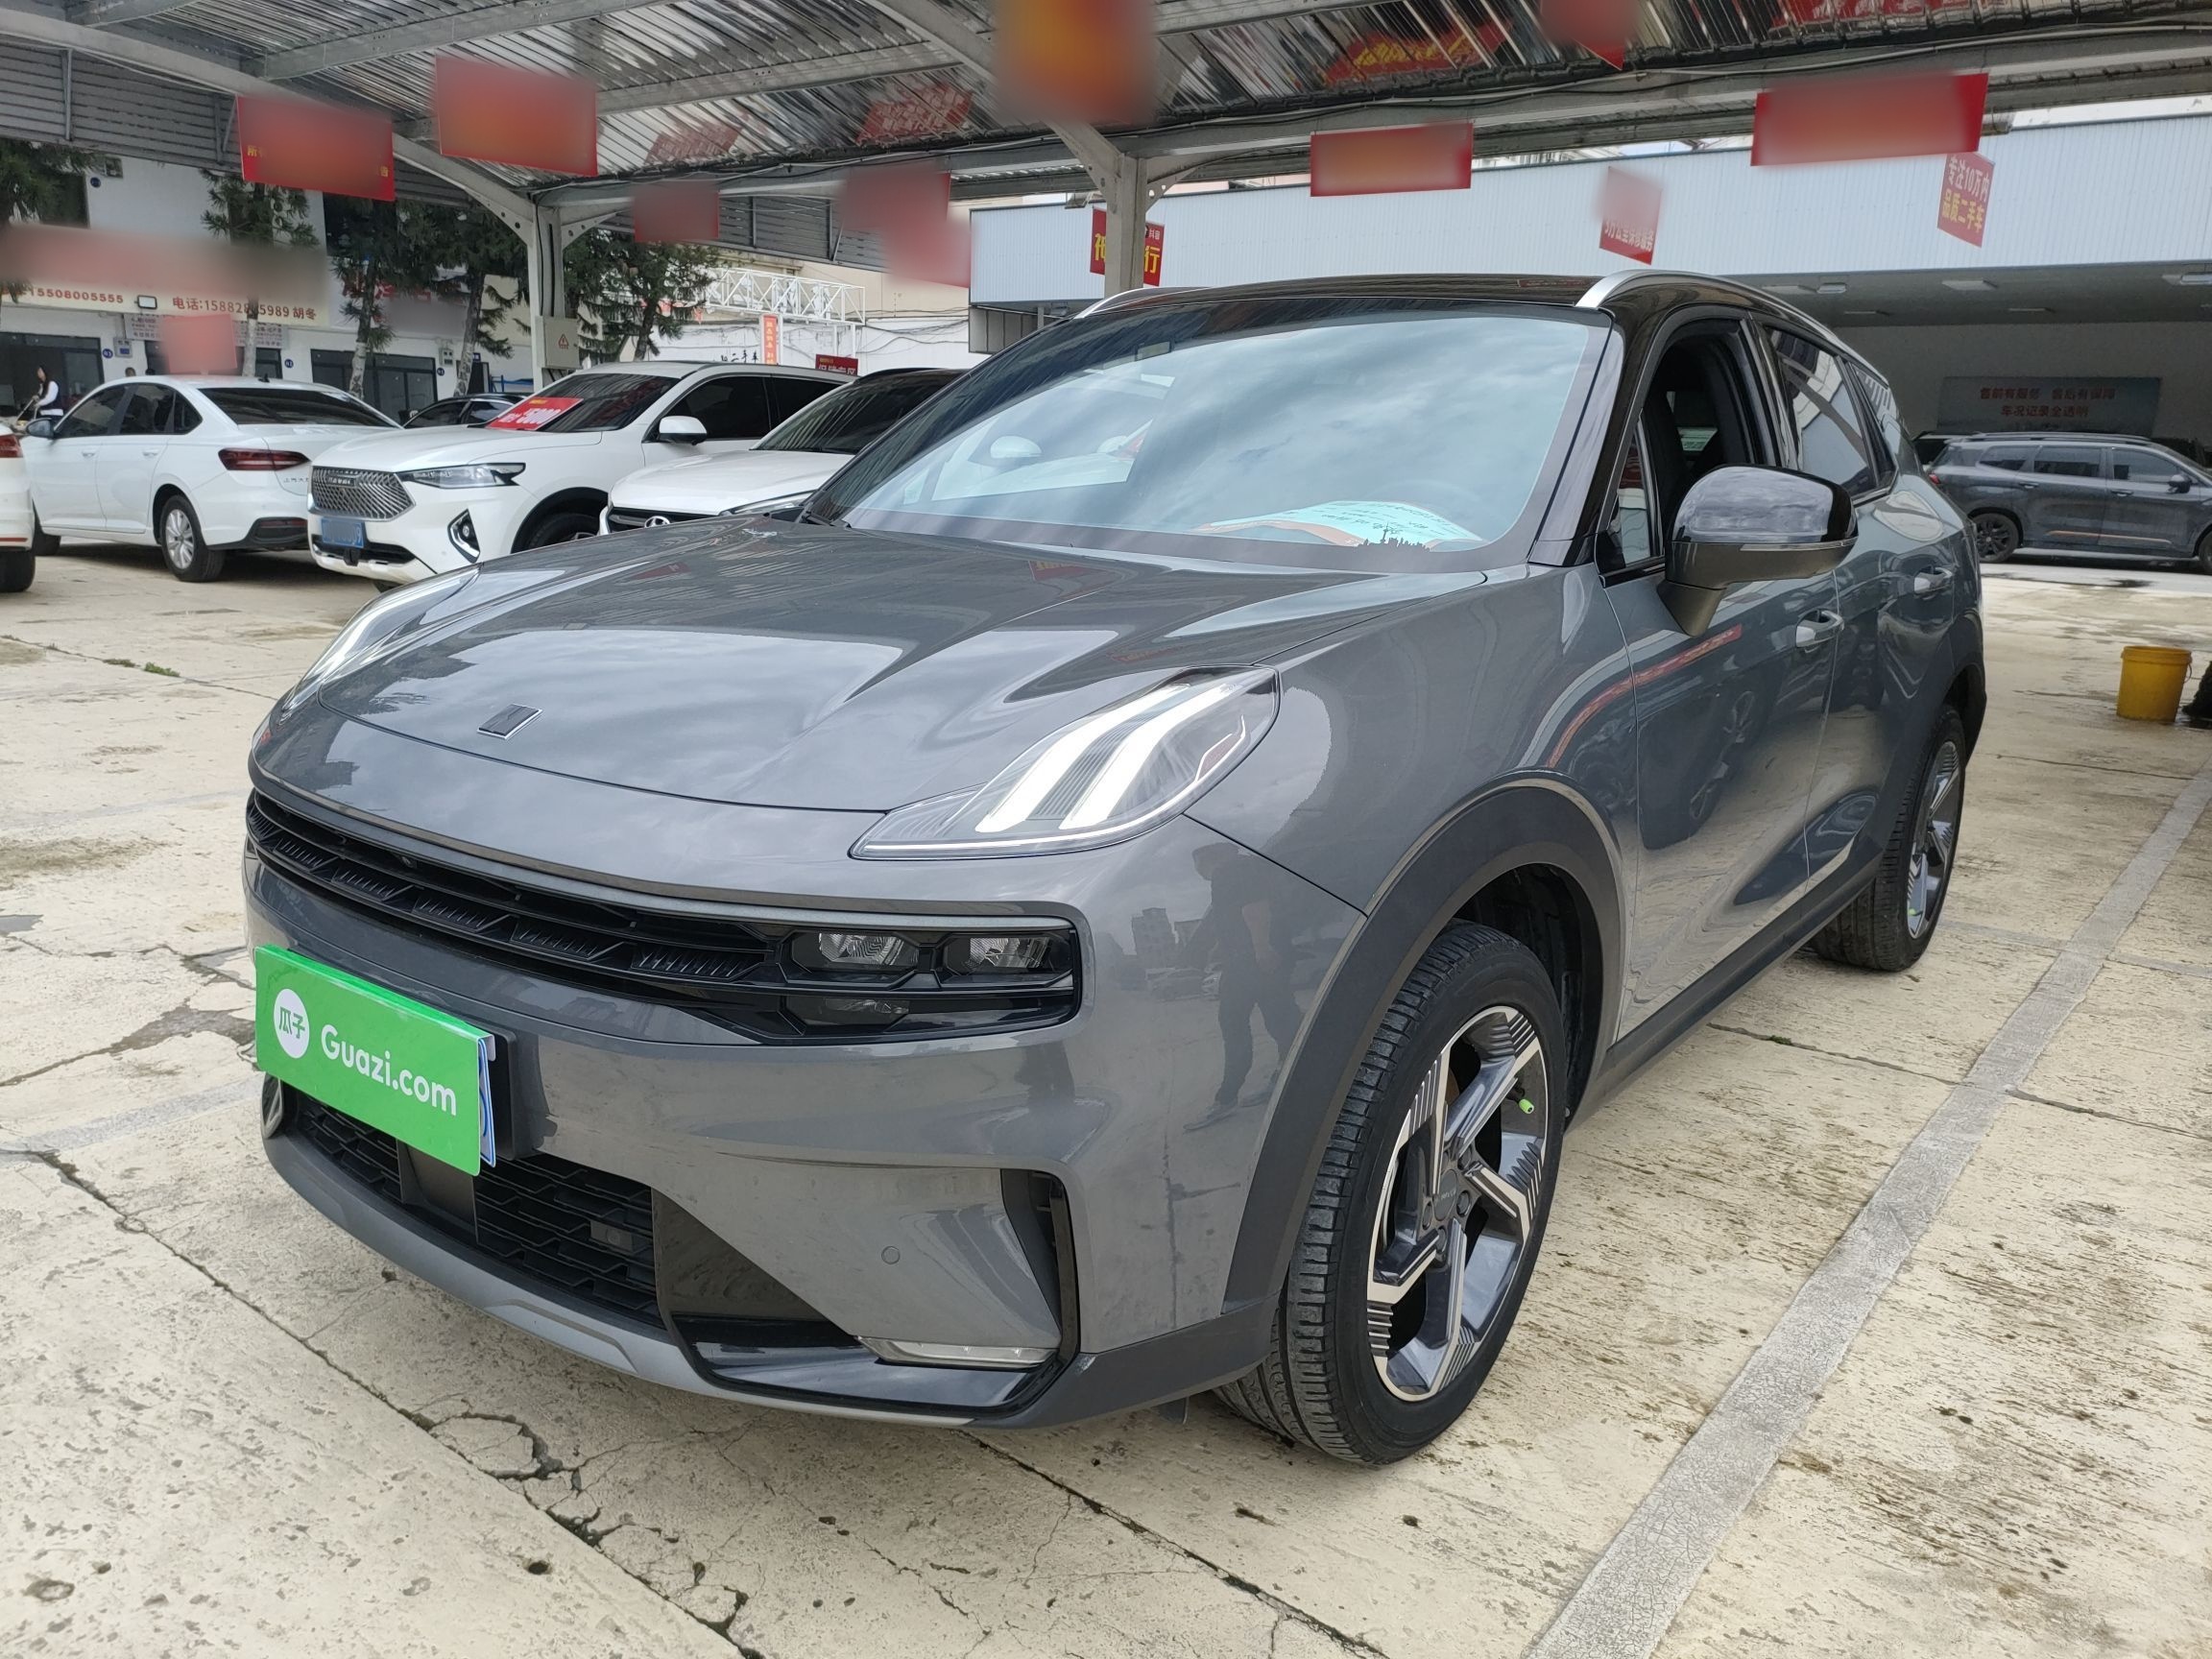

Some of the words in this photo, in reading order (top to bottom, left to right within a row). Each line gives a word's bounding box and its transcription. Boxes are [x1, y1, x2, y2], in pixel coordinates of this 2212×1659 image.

[1948, 155, 1991, 203] 专注10万内
[1942, 188, 1985, 233] 品质二手车
[173, 296, 289, 317] 电话:1588285989
[278, 1006, 305, 1039] 瓜子
[321, 1023, 457, 1117] Guazi.com
